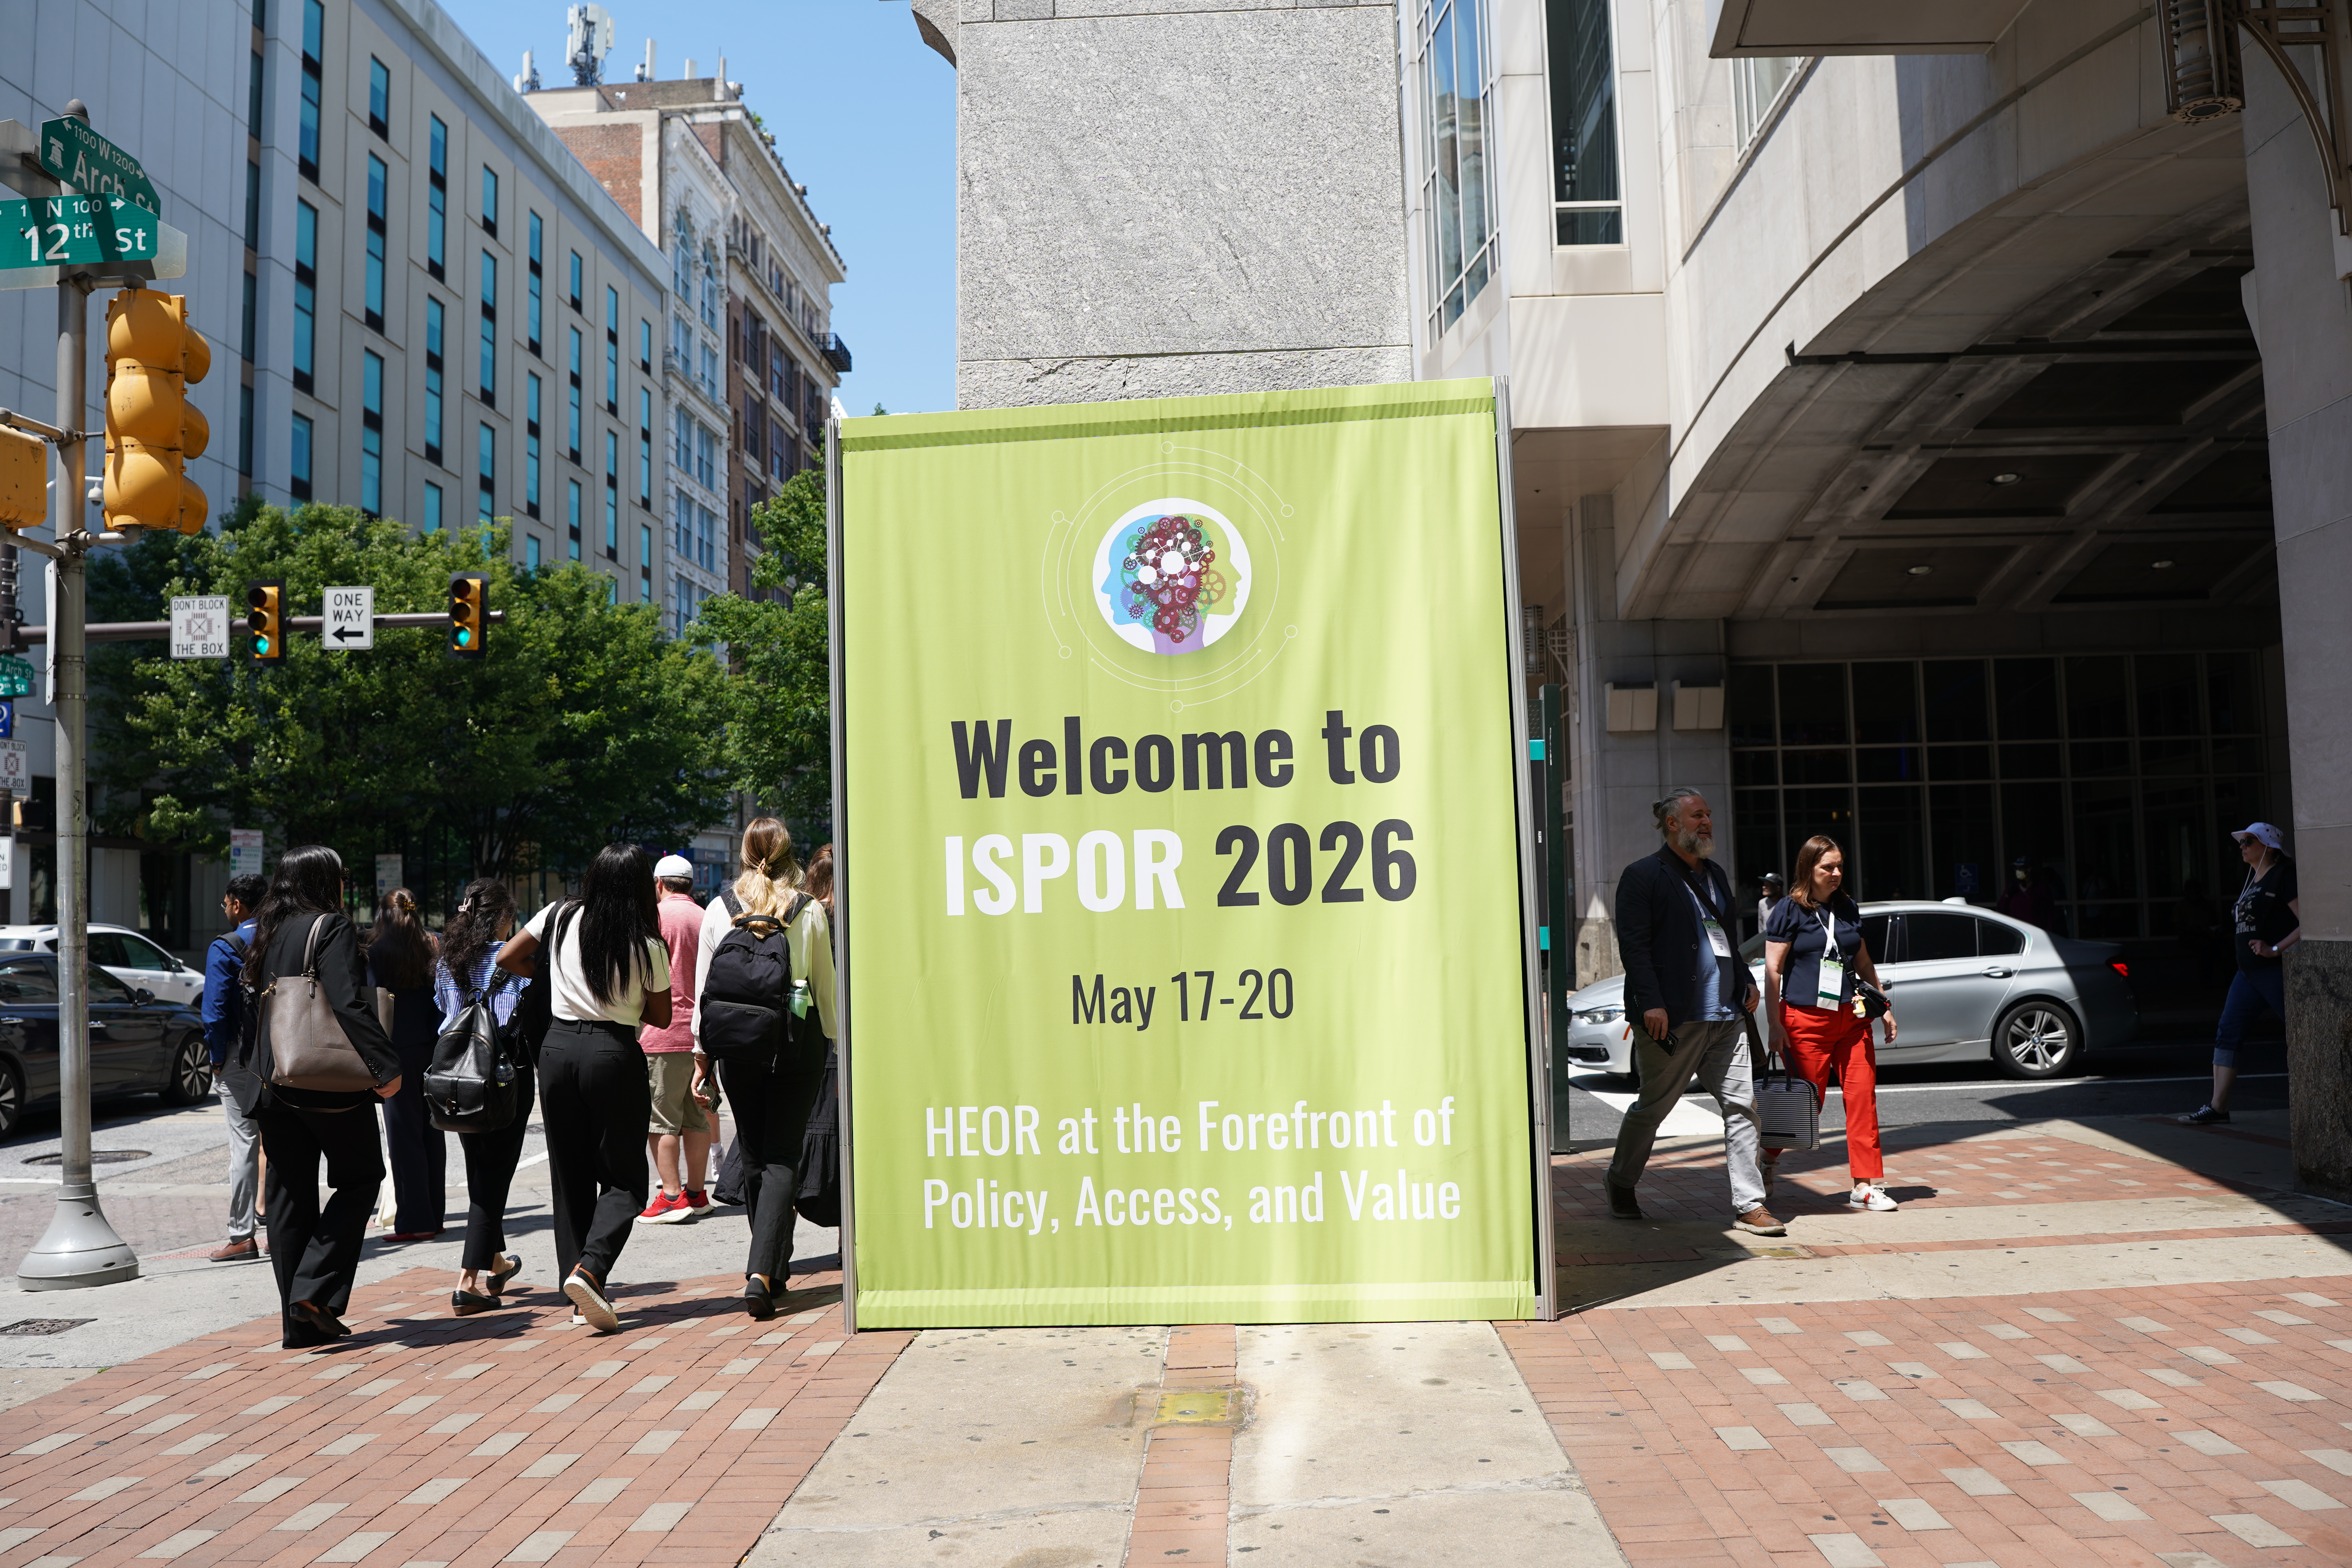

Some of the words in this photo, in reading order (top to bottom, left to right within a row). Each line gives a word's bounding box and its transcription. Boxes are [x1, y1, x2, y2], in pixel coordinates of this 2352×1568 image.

[74, 125, 96, 149] 1100
[99, 138, 110, 160] W
[112, 151, 135, 175] 1200
[20, 204, 26, 217] 1
[47, 199, 62, 218] N
[73, 199, 102, 214] 100
[24, 222, 93, 261] 12th
[115, 228, 146, 252] St
[174, 599, 196, 610] DON'T
[199, 599, 224, 610] BLOCK
[334, 593, 362, 606] ONE
[333, 610, 363, 622] WAY
[175, 643, 196, 655] THE
[201, 642, 223, 654] BOX
[5, 662, 22, 677] Arch
[25, 668, 32, 679] St
[15, 684, 25, 692] St
[11, 742, 25, 752] BLOCK
[951, 716, 1293, 799] Welcome
[1322, 710, 1400, 784] to
[13, 777, 24, 788] BOX
[946, 829, 1185, 915] ISPOR
[1216, 819, 1416, 907] 2026
[1073, 975, 1156, 1031] May
[1172, 969, 1293, 1021] 17-20
[926, 1105, 1041, 1156] HEOR
[1058, 1108, 1098, 1154] at
[1113, 1103, 1181, 1153] the
[1199, 1100, 1397, 1151] Forefront
[1414, 1096, 1454, 1146] of
[924, 1179, 1058, 1235] Policy,
[1075, 1176, 1232, 1231] Access,
[1249, 1171, 1323, 1223] and
[1340, 1169, 1460, 1221] Value
